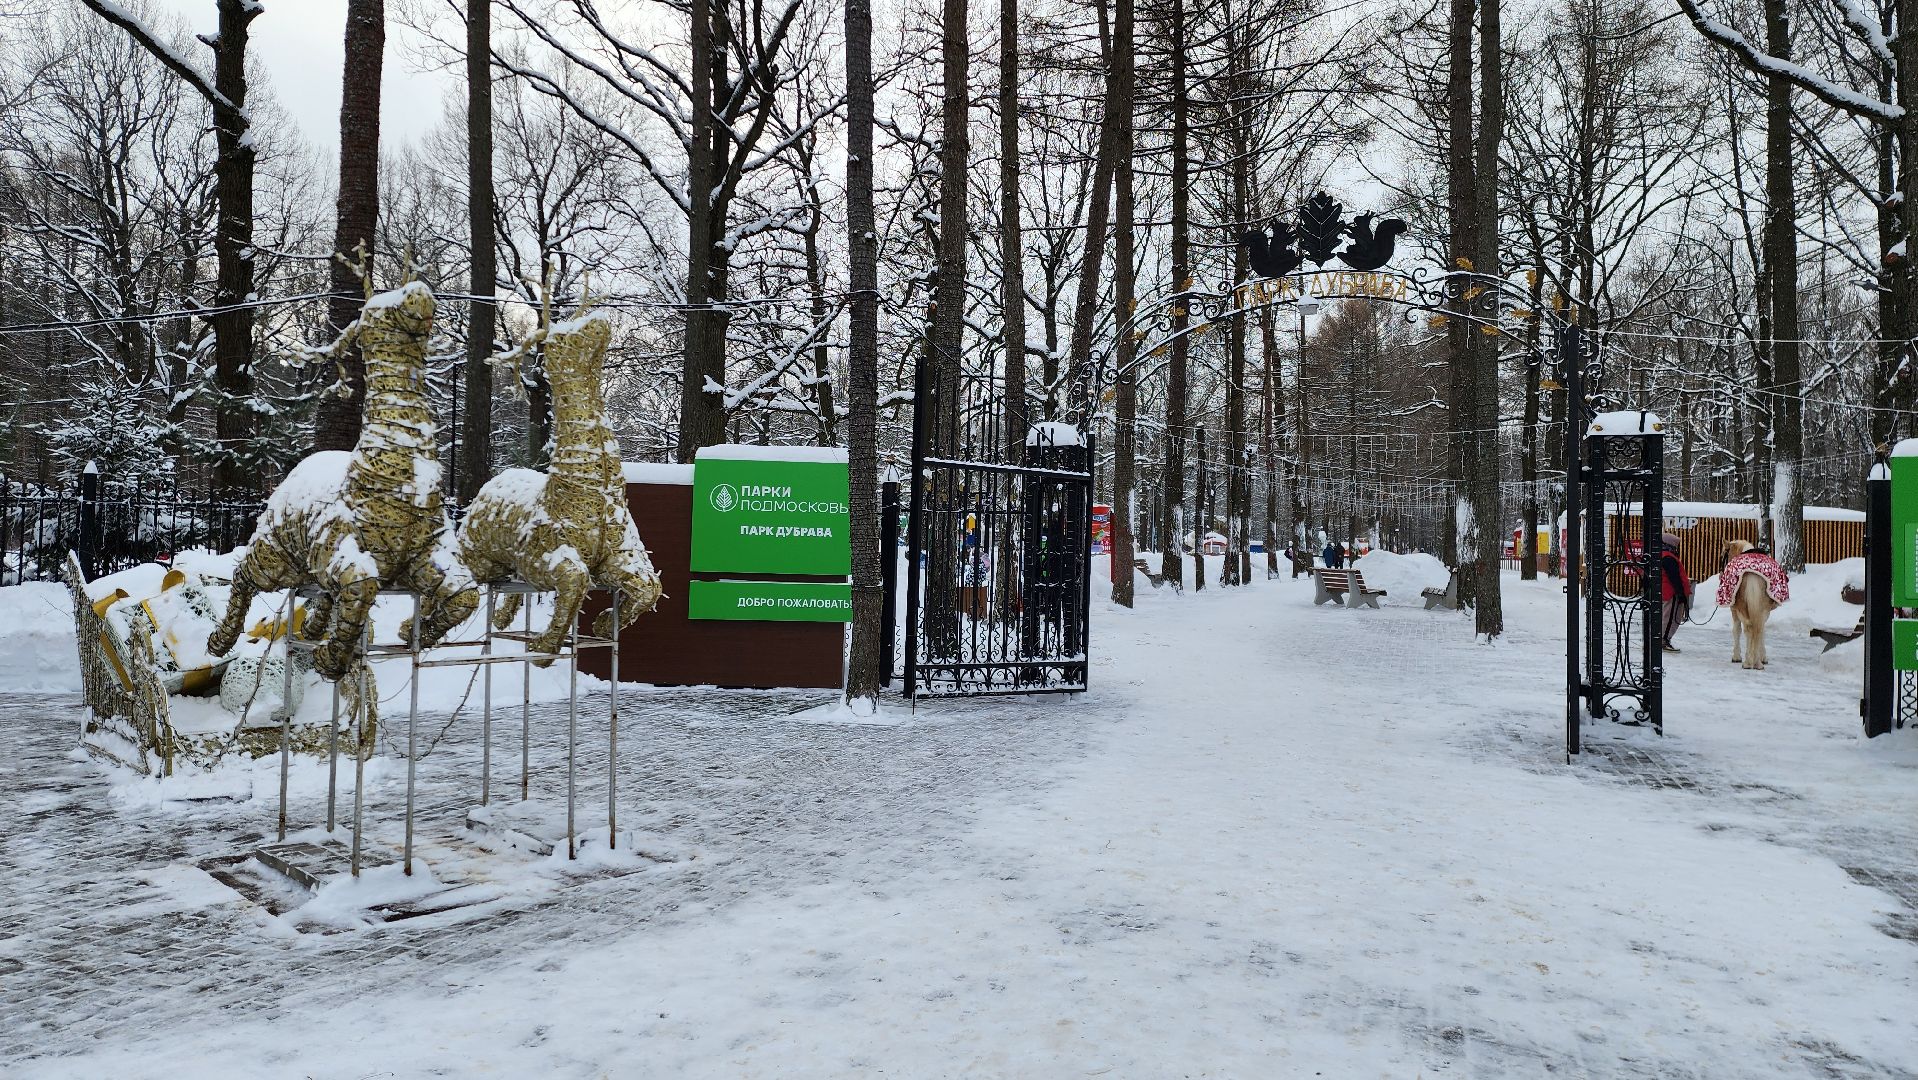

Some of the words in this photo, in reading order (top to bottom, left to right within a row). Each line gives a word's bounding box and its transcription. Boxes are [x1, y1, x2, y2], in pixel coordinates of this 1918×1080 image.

[1234, 278, 1297, 311] ПАРК
[741, 486, 791, 497] ПАРКИ
[740, 500, 849, 513] ПОДМОСКОВЬ
[740, 525, 774, 536] ПАРК
[776, 526, 833, 538] ДУБРАВА
[738, 597, 775, 608] ДОБРО
